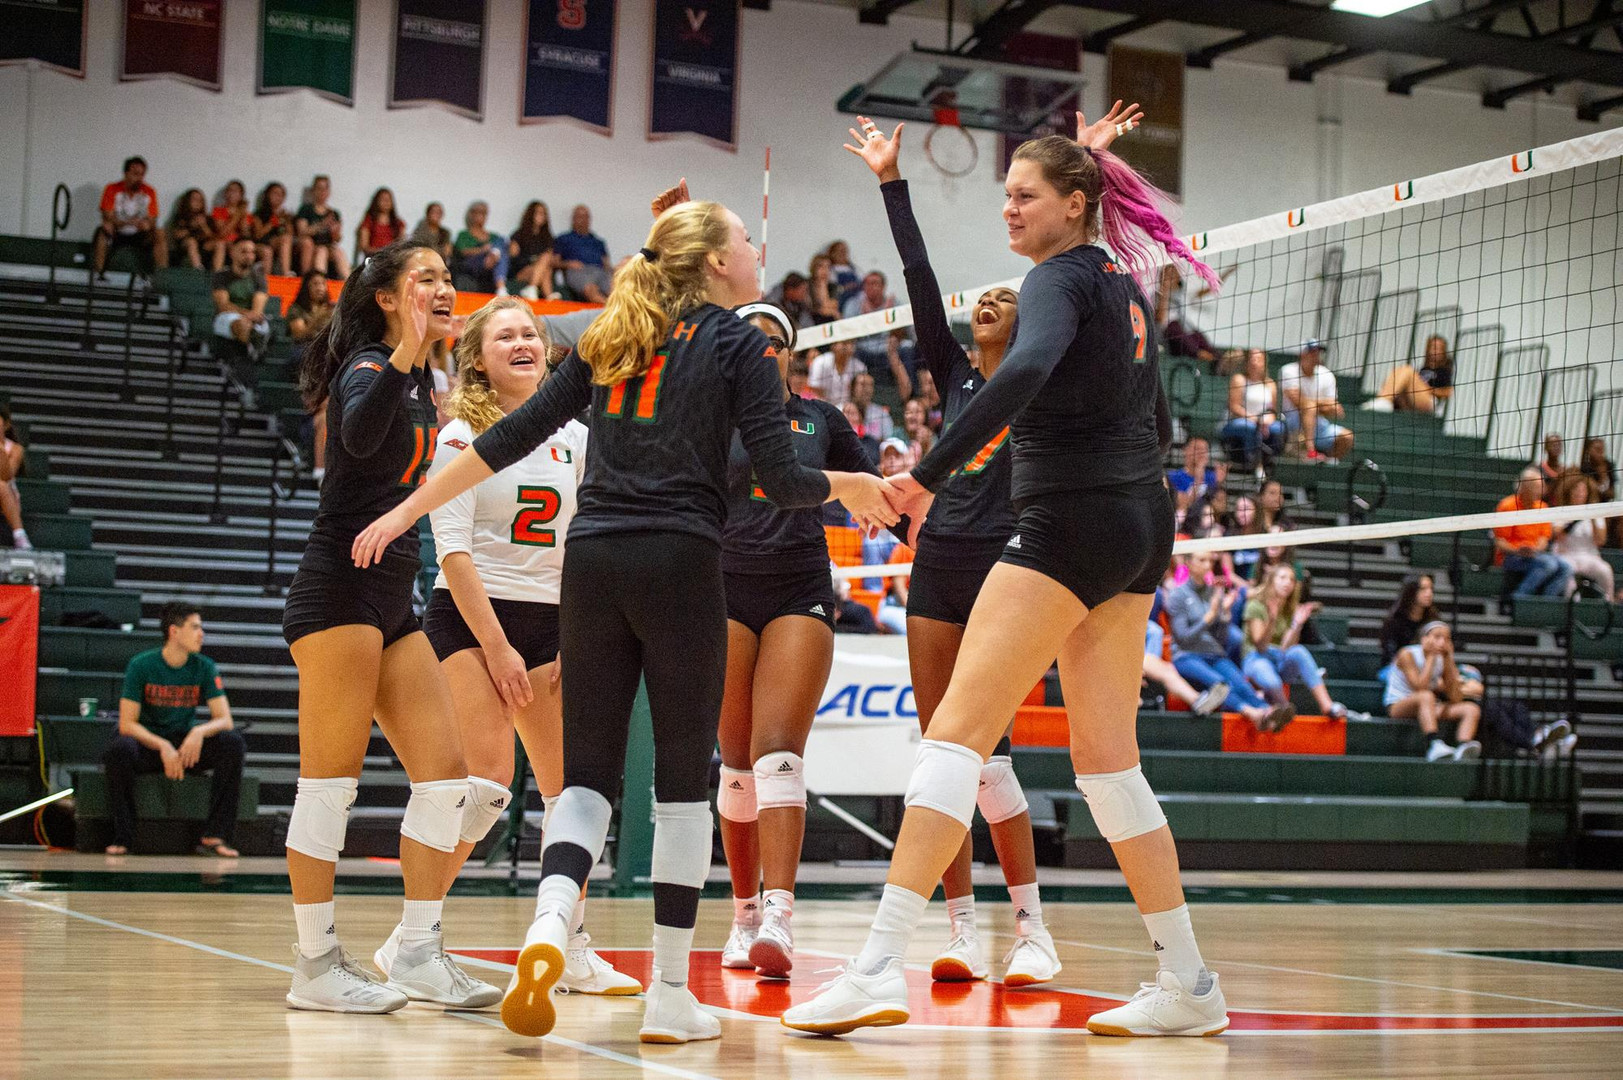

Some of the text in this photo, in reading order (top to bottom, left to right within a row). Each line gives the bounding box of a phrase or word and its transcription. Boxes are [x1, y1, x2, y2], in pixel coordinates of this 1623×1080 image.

[684, 7, 708, 32] V
[1512, 150, 1533, 173] U
[1394, 180, 1413, 202] U
[1288, 208, 1305, 228] U
[1192, 232, 1208, 251] U
[1129, 299, 1147, 363] 9
[791, 419, 815, 435] U
[550, 447, 572, 464] U
[510, 484, 562, 548] 2
